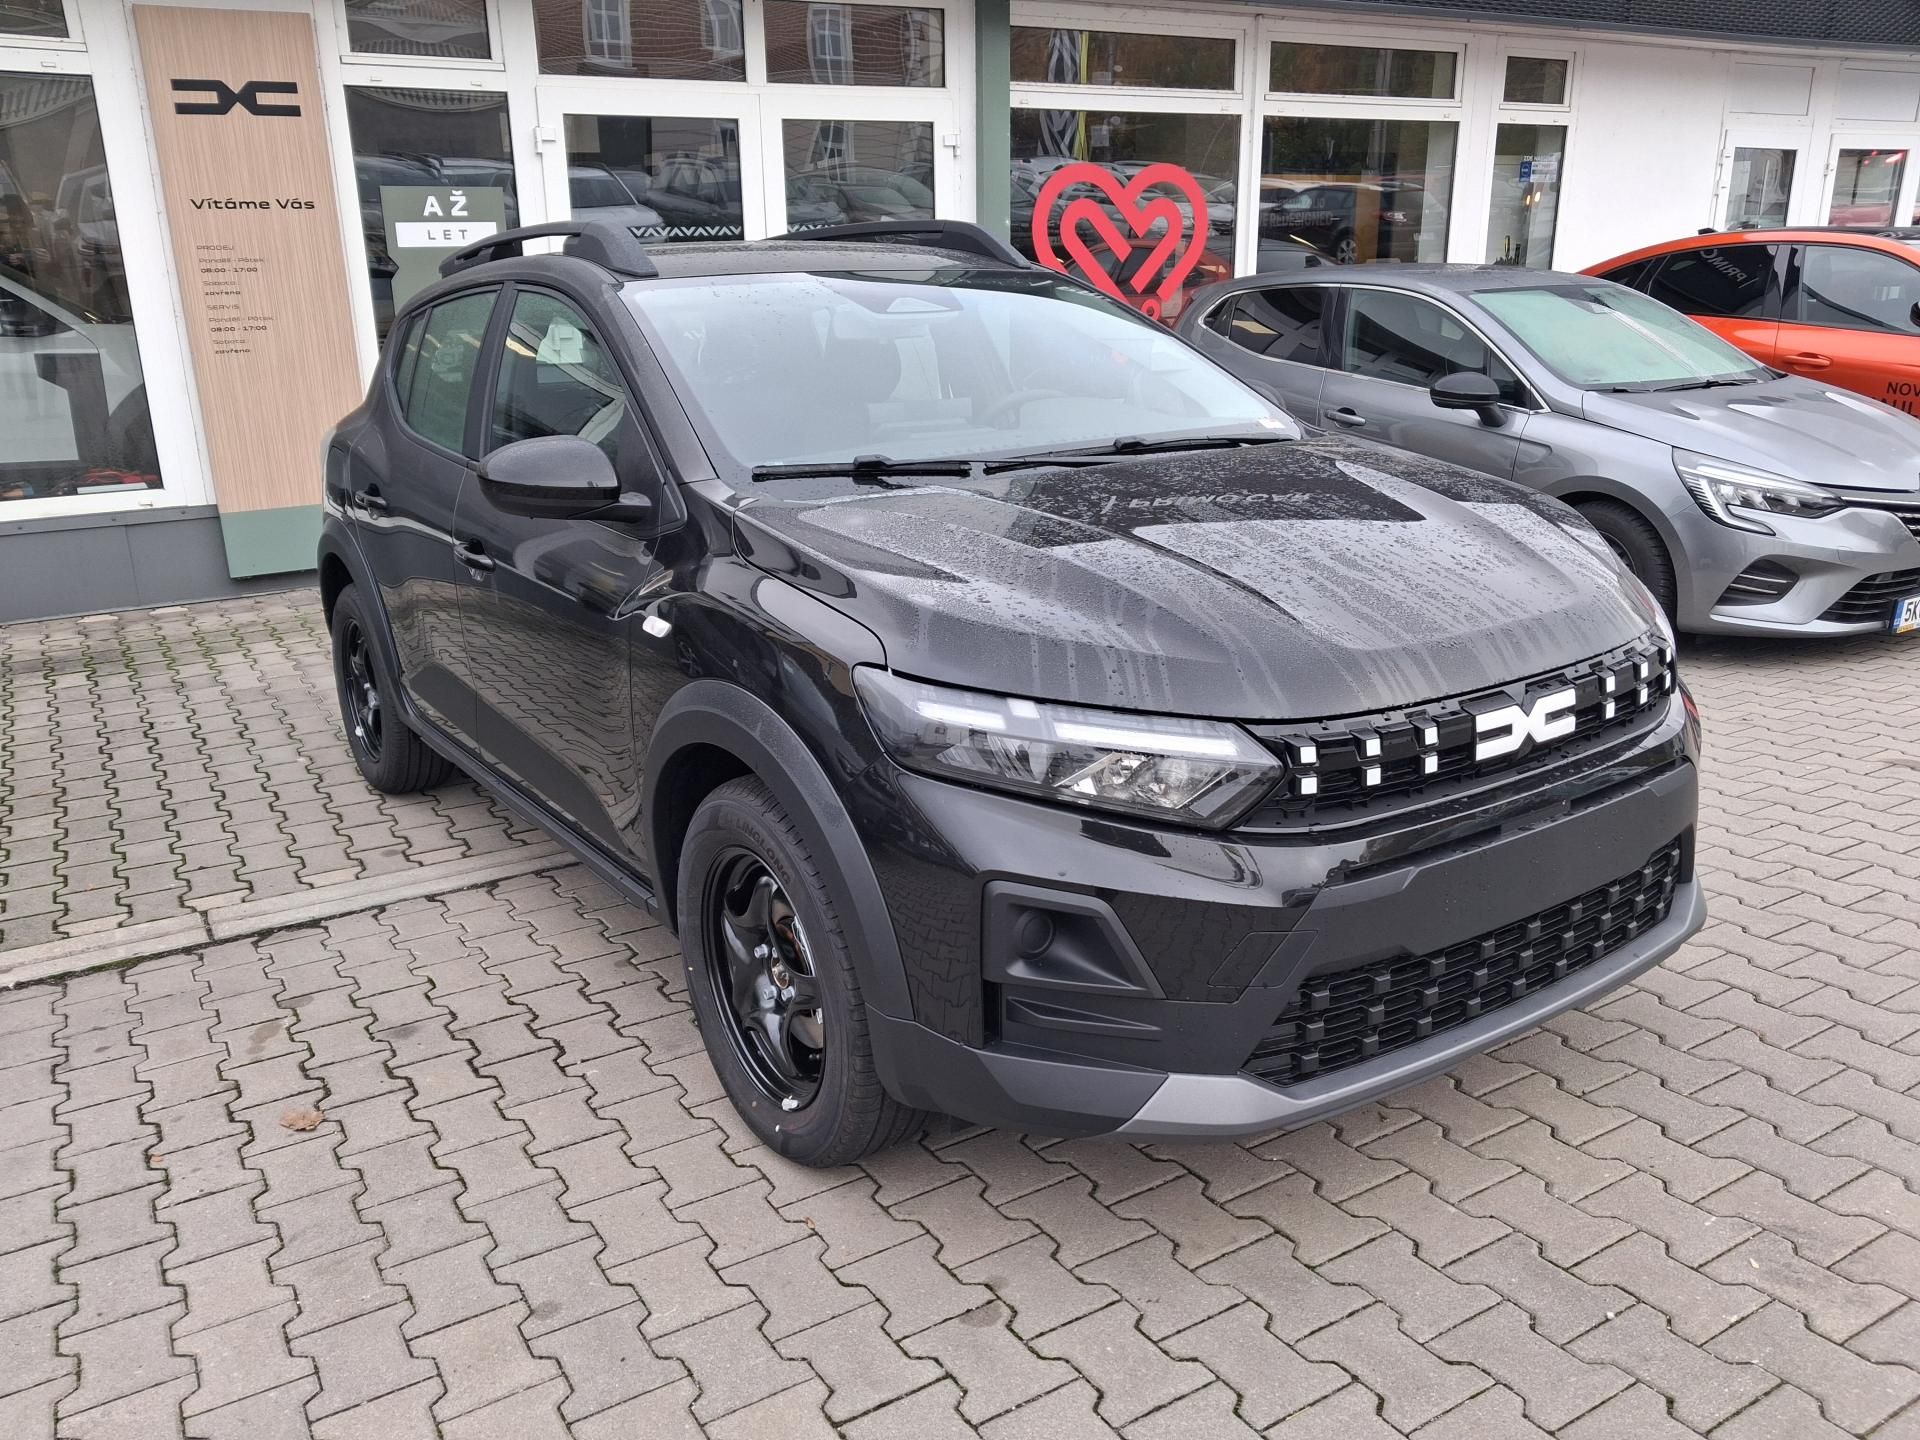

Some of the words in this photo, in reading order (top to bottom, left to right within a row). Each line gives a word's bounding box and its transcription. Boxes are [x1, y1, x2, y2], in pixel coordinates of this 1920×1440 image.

[190, 198, 271, 210] Vítáme
[275, 198, 315, 210] Vás
[423, 190, 468, 216] AŽ
[427, 229, 468, 241] LET
